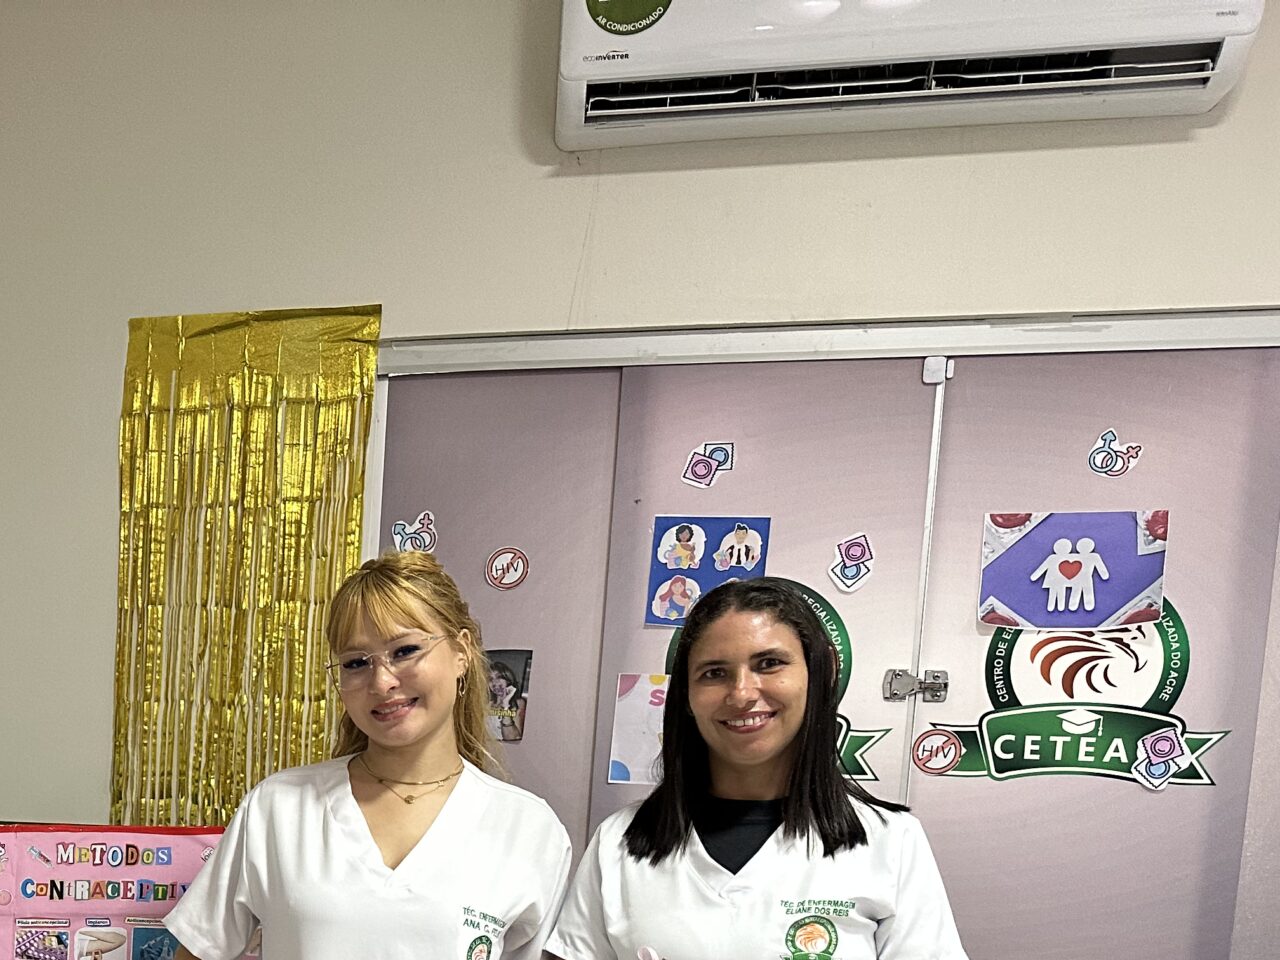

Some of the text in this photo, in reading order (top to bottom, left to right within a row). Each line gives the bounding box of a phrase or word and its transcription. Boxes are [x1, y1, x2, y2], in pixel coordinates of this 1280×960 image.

[596, 6, 664, 32] AR CONDICIONADO
[494, 561, 521, 576] HIV
[995, 641, 1009, 657] DE
[1170, 651, 1181, 669] DO
[993, 658, 1009, 703] CENTRO
[1158, 670, 1179, 702] ACRE
[921, 744, 952, 759] HIV
[993, 734, 1129, 764] CETEA
[785, 906, 850, 917] ELIANE DOS REIS
[462, 918, 480, 931] ANA
